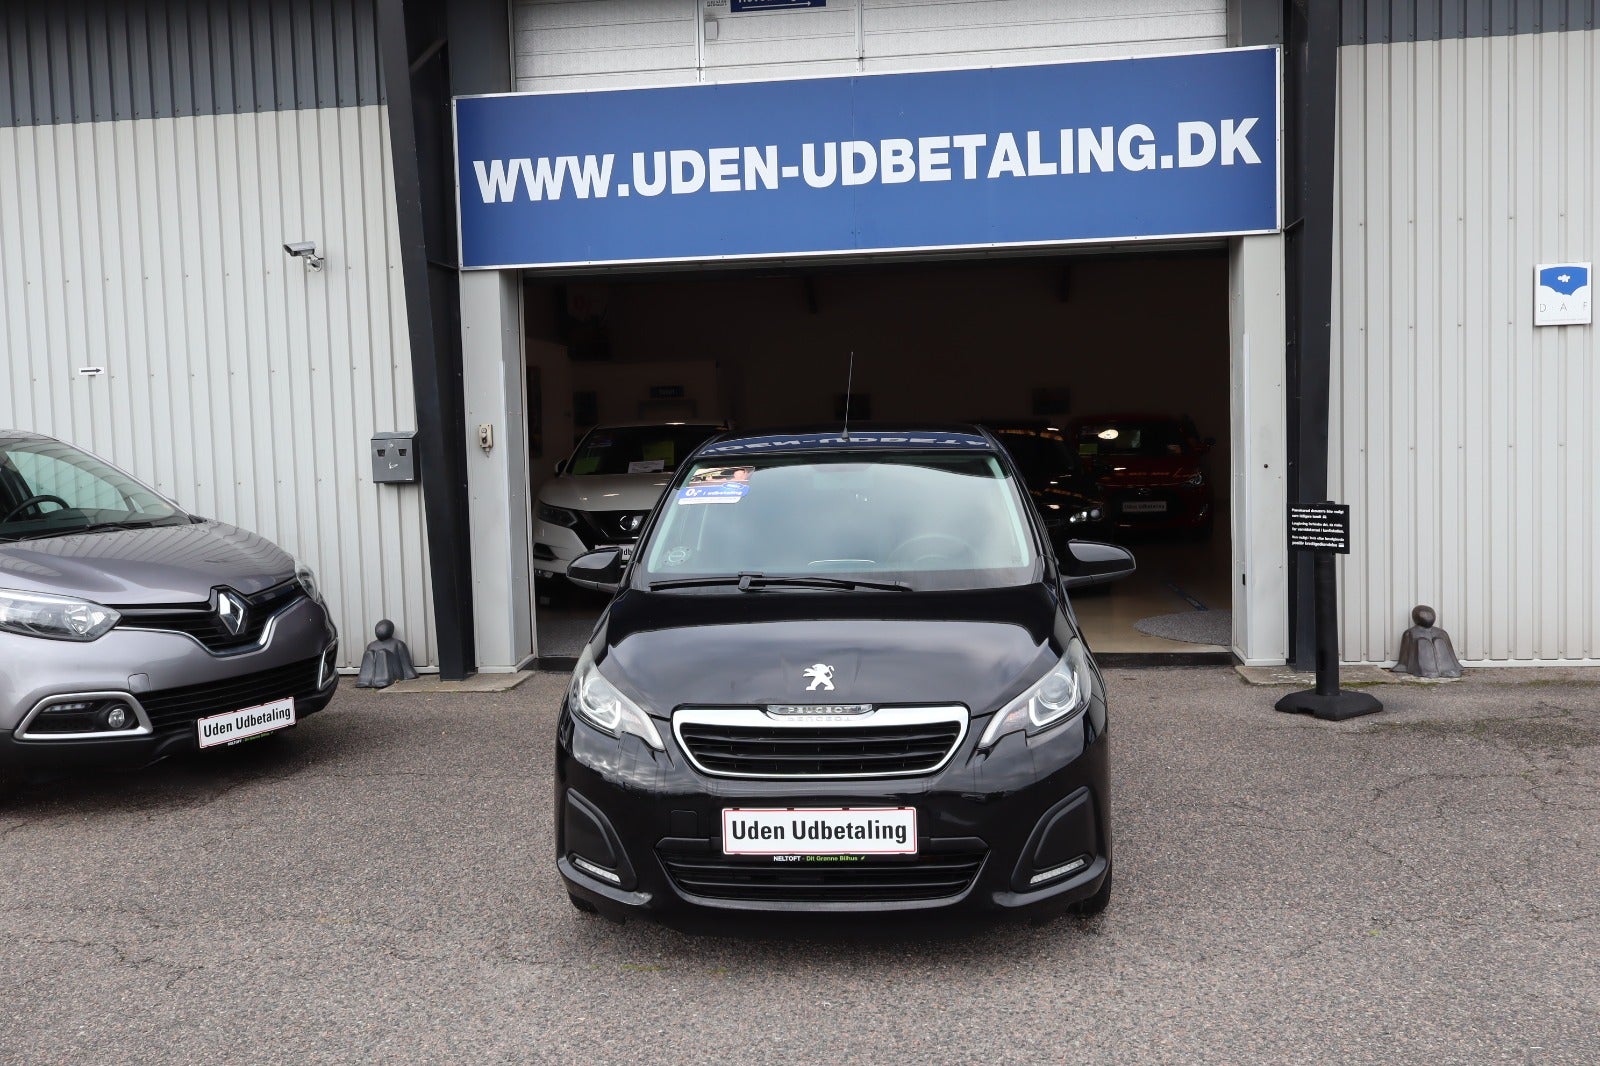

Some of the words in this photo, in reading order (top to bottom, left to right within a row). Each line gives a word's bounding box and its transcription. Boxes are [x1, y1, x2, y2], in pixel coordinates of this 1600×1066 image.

[473, 117, 1262, 203] WWW.UDEN-UDBETALING.DK
[203, 721, 233, 738] Uden
[235, 707, 291, 730] Udbetaling
[732, 820, 785, 840] Uden
[792, 820, 907, 844] Udbetaling
